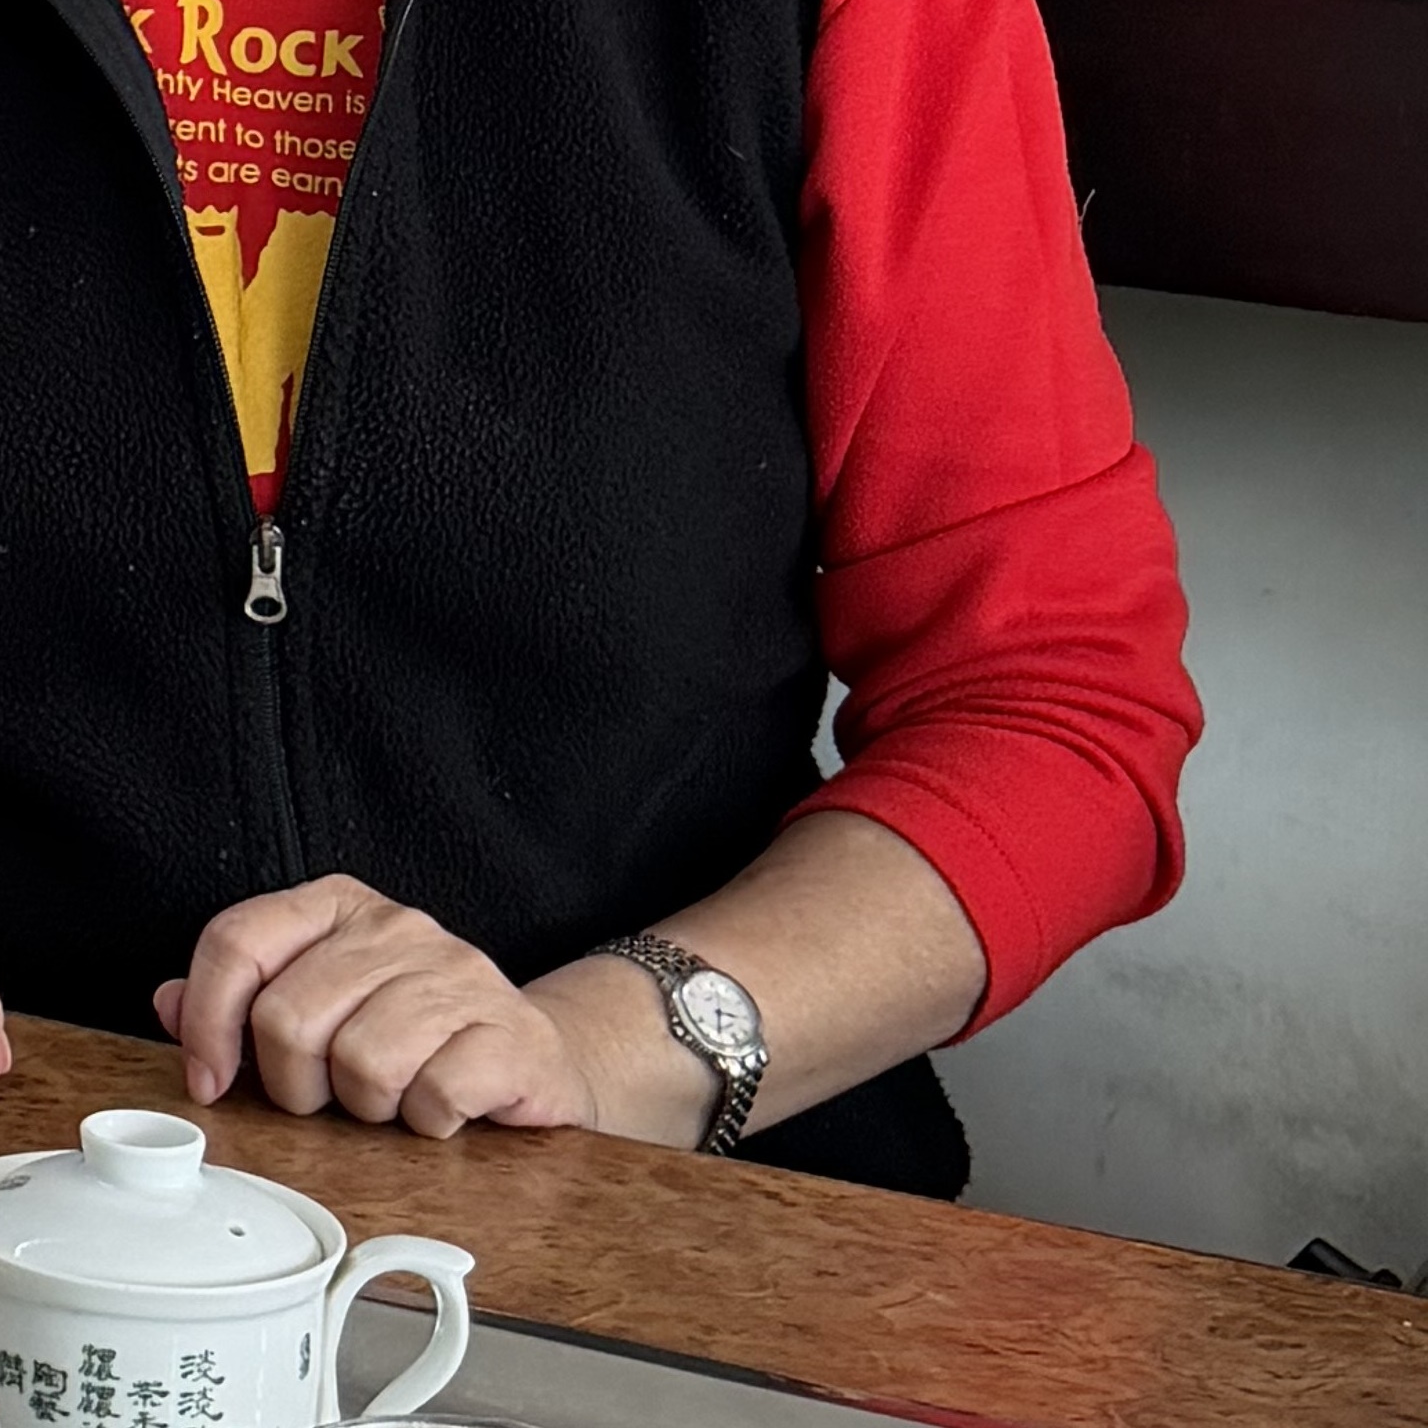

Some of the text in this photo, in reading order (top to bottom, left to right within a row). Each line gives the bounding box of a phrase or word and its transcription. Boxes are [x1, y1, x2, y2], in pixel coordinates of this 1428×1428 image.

[212, 78, 334, 115] Heaven
[346, 89, 366, 115] is
[235, 121, 265, 149] to
[274, 129, 357, 161] those
[208, 160, 261, 185] are
